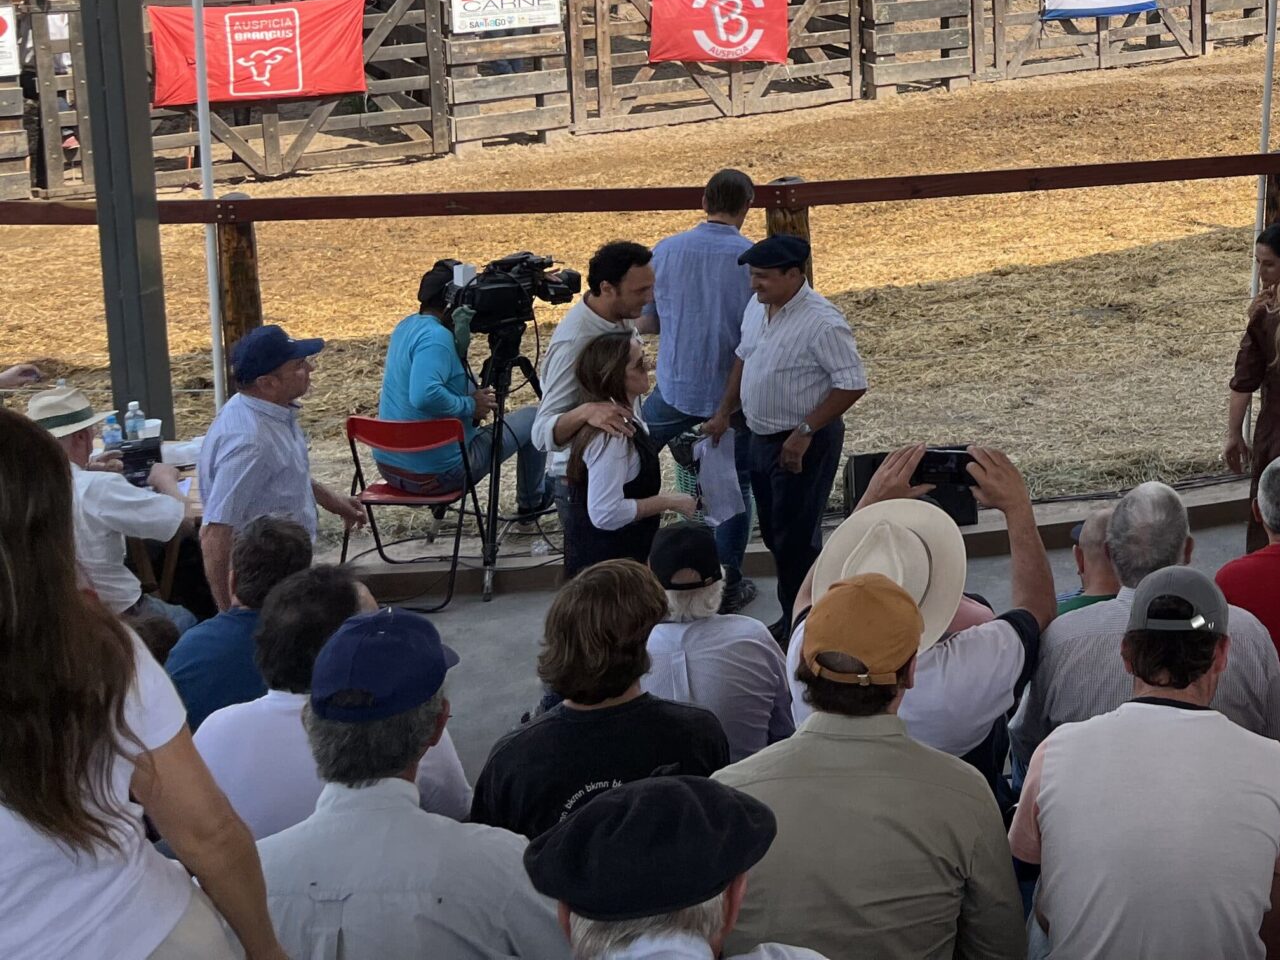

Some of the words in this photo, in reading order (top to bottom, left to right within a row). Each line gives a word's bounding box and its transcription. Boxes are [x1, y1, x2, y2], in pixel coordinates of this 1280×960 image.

[233, 17, 294, 31] AUSPICIA
[234, 28, 294, 43] BRANGUS
[708, 45, 749, 59] AUSPICIA
[564, 789, 586, 810] bkmn
[585, 780, 610, 793] bkmn
